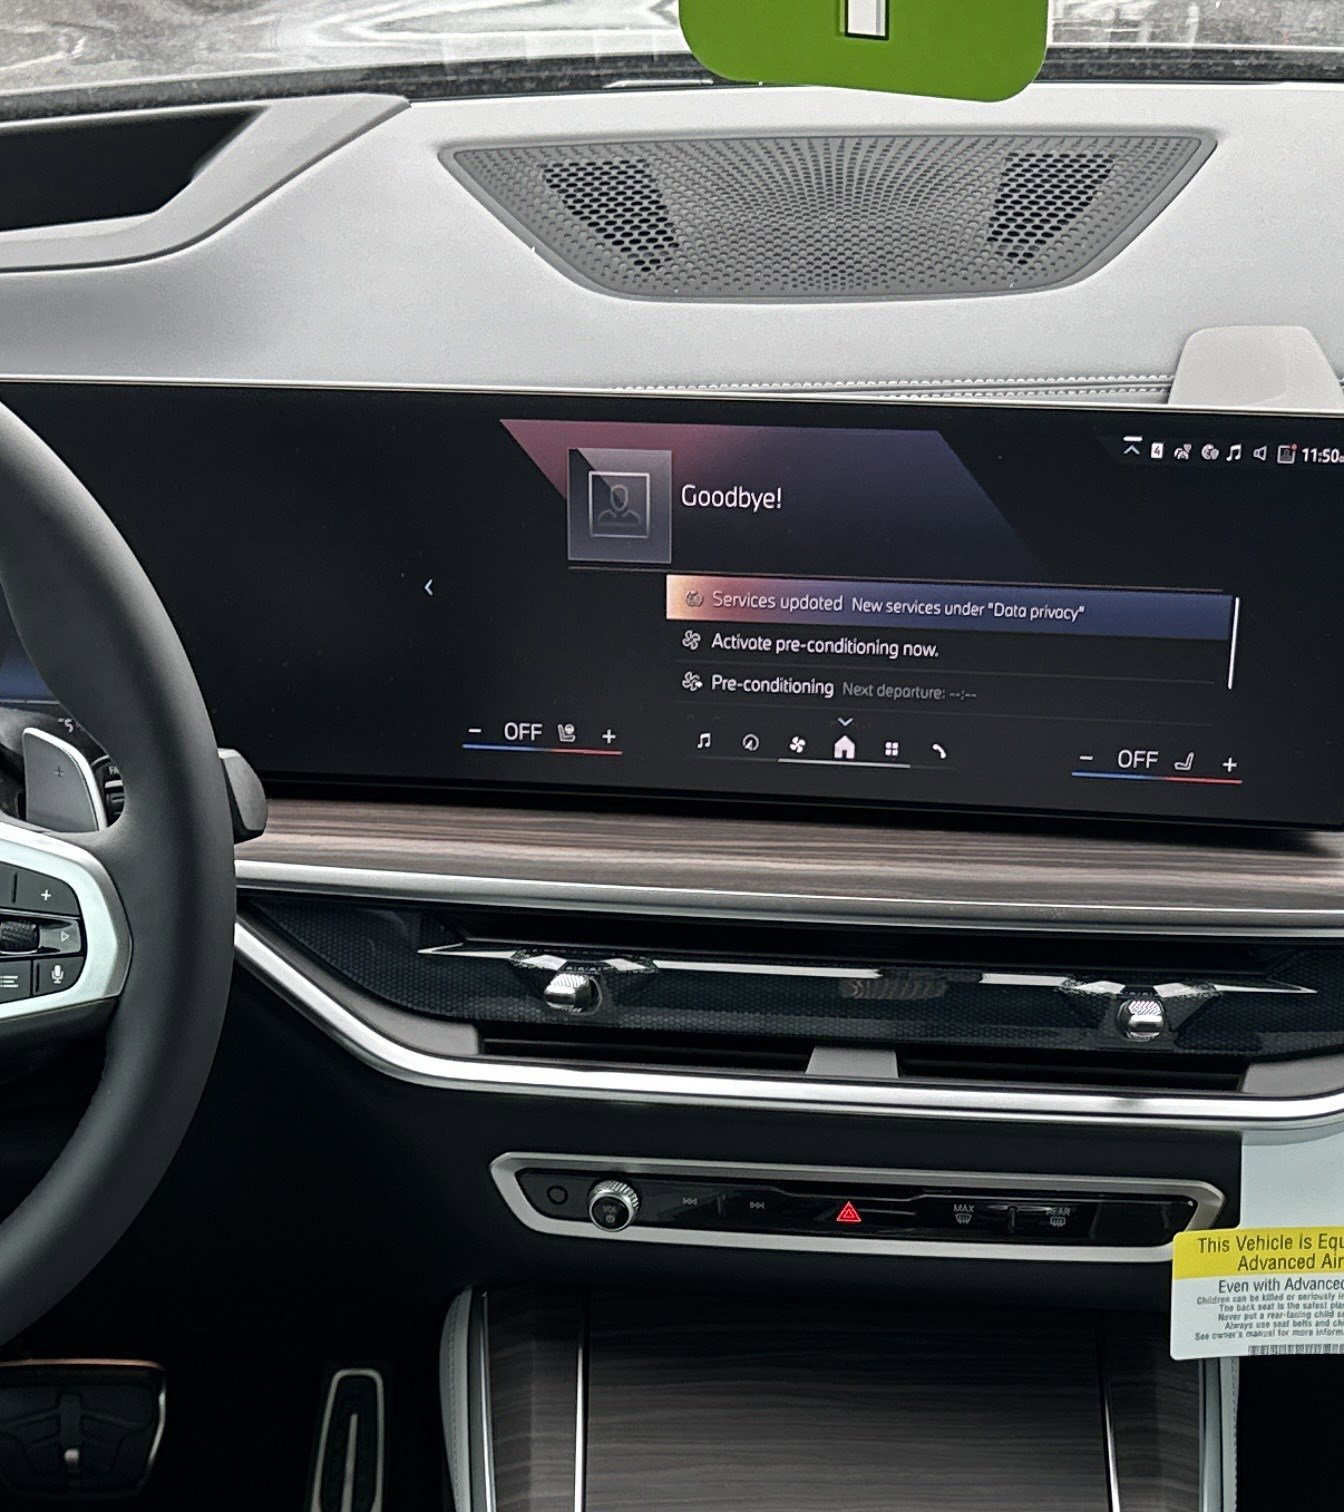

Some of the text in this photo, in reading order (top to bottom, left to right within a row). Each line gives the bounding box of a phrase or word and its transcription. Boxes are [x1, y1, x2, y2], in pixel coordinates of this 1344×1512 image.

[681, 484, 782, 513] Goodbye!
[712, 590, 776, 609] Services
[780, 594, 844, 613] updated
[851, 598, 883, 613] New
[885, 599, 941, 615] services
[944, 601, 986, 617] under
[711, 632, 939, 660] Activate pre-conditioning now.
[711, 673, 834, 698] Pre-conditioning
[842, 682, 873, 698] Next
[877, 683, 946, 701] departure:
[504, 722, 543, 741] OFF
[1118, 750, 1159, 769] OFF
[1197, 1237, 1230, 1254] This
[1236, 1234, 1293, 1251] Vehicle
[1237, 1253, 1316, 1271] Advanced
[1321, 1253, 1344, 1269] Air
[1218, 1279, 1249, 1293] Even
[1253, 1278, 1280, 1291] with
[1196, 1296, 1229, 1305] Children
[1250, 1294, 1258, 1302] be
[1262, 1293, 1284, 1301] killed
[1219, 1304, 1234, 1312] The
[1236, 1303, 1255, 1311] back
[1258, 1302, 1274, 1310] seat
[1273, 1320, 1289, 1328] seat
[1195, 1332, 1209, 1340] See
